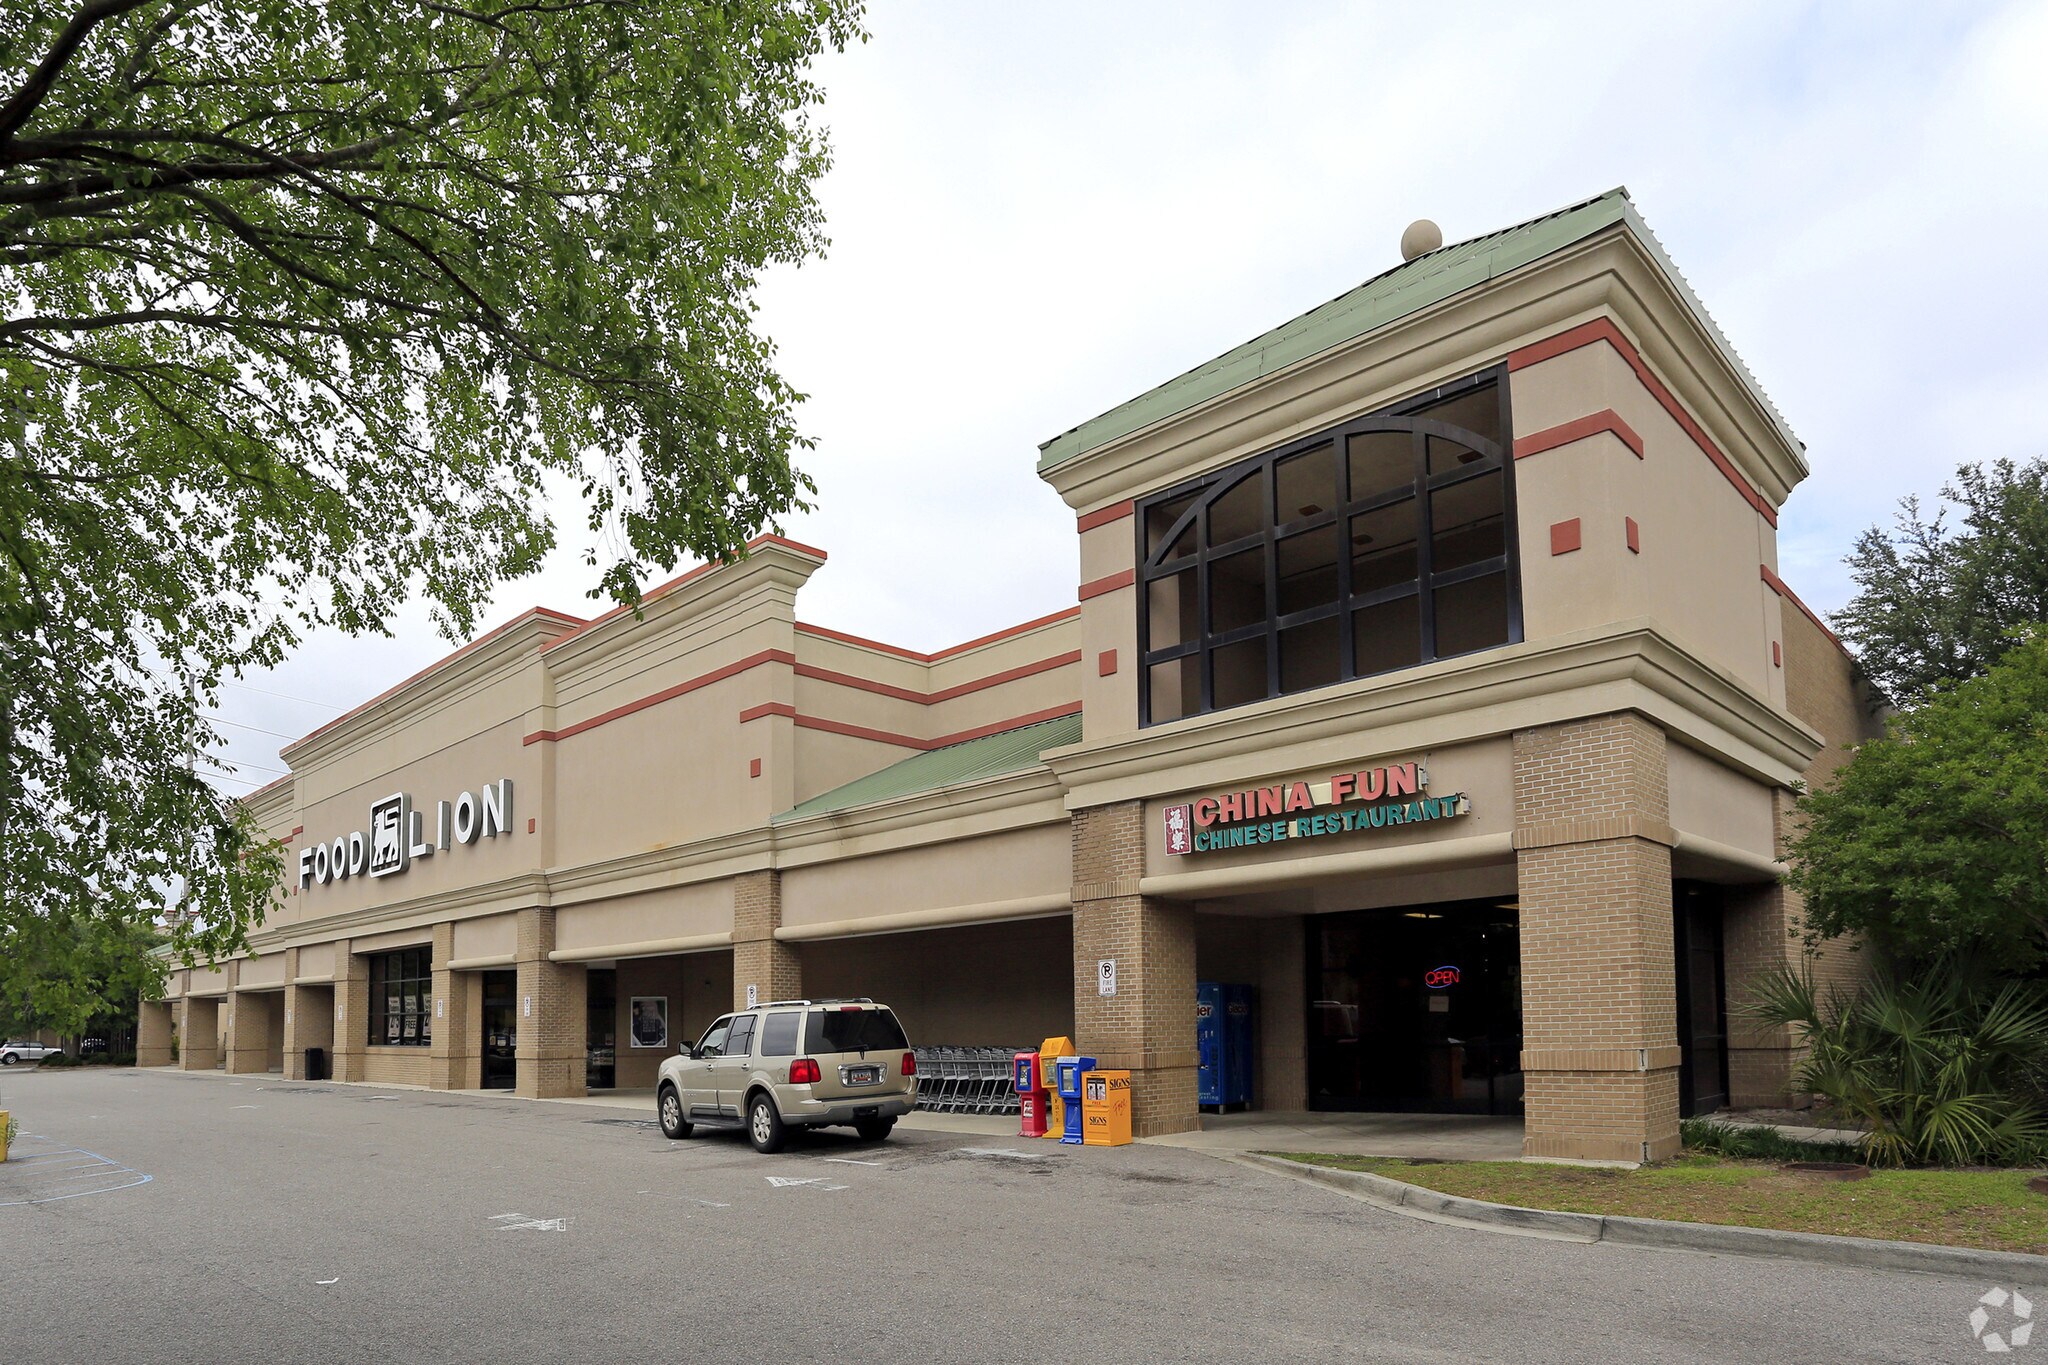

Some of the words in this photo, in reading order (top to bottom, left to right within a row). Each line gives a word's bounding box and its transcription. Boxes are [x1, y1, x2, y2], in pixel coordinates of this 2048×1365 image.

[1194, 780, 1312, 827] CHINA
[1331, 762, 1418, 806] FUN
[299, 830, 368, 890] FOOD
[409, 778, 512, 859] LION
[1196, 820, 1287, 851] CHINESE
[1296, 795, 1458, 838] RESTAURANT
[1425, 971, 1460, 985] OPEN
[1109, 1078, 1130, 1089] SIGNS
[1089, 1116, 1107, 1124] SIGNS
